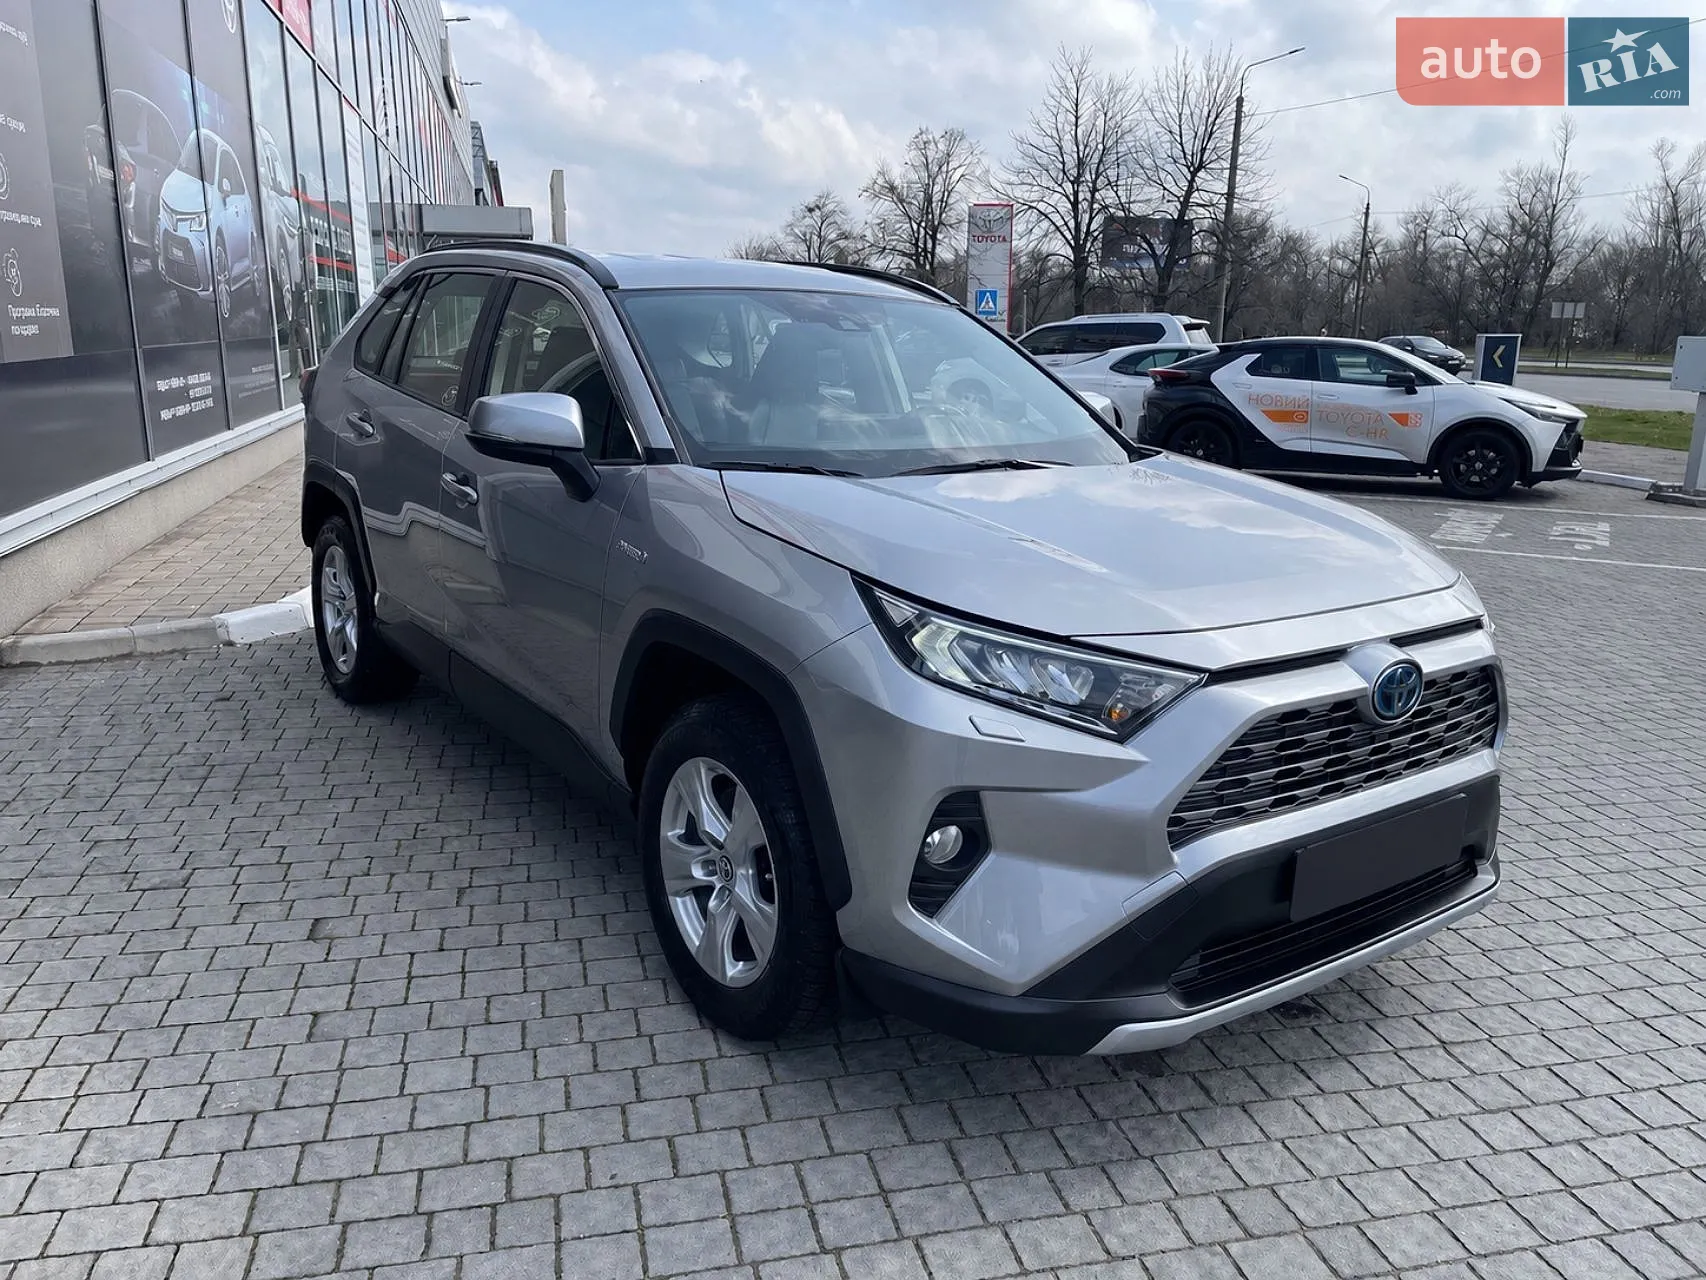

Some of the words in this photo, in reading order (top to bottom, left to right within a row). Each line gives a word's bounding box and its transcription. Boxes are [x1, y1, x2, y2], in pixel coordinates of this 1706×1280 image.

[972, 235, 1007, 243] TOYOTA
[1248, 393, 1310, 410] НОВИЙ
[1317, 409, 1384, 426] TOYOTA
[1345, 426, 1389, 440] C-HR
